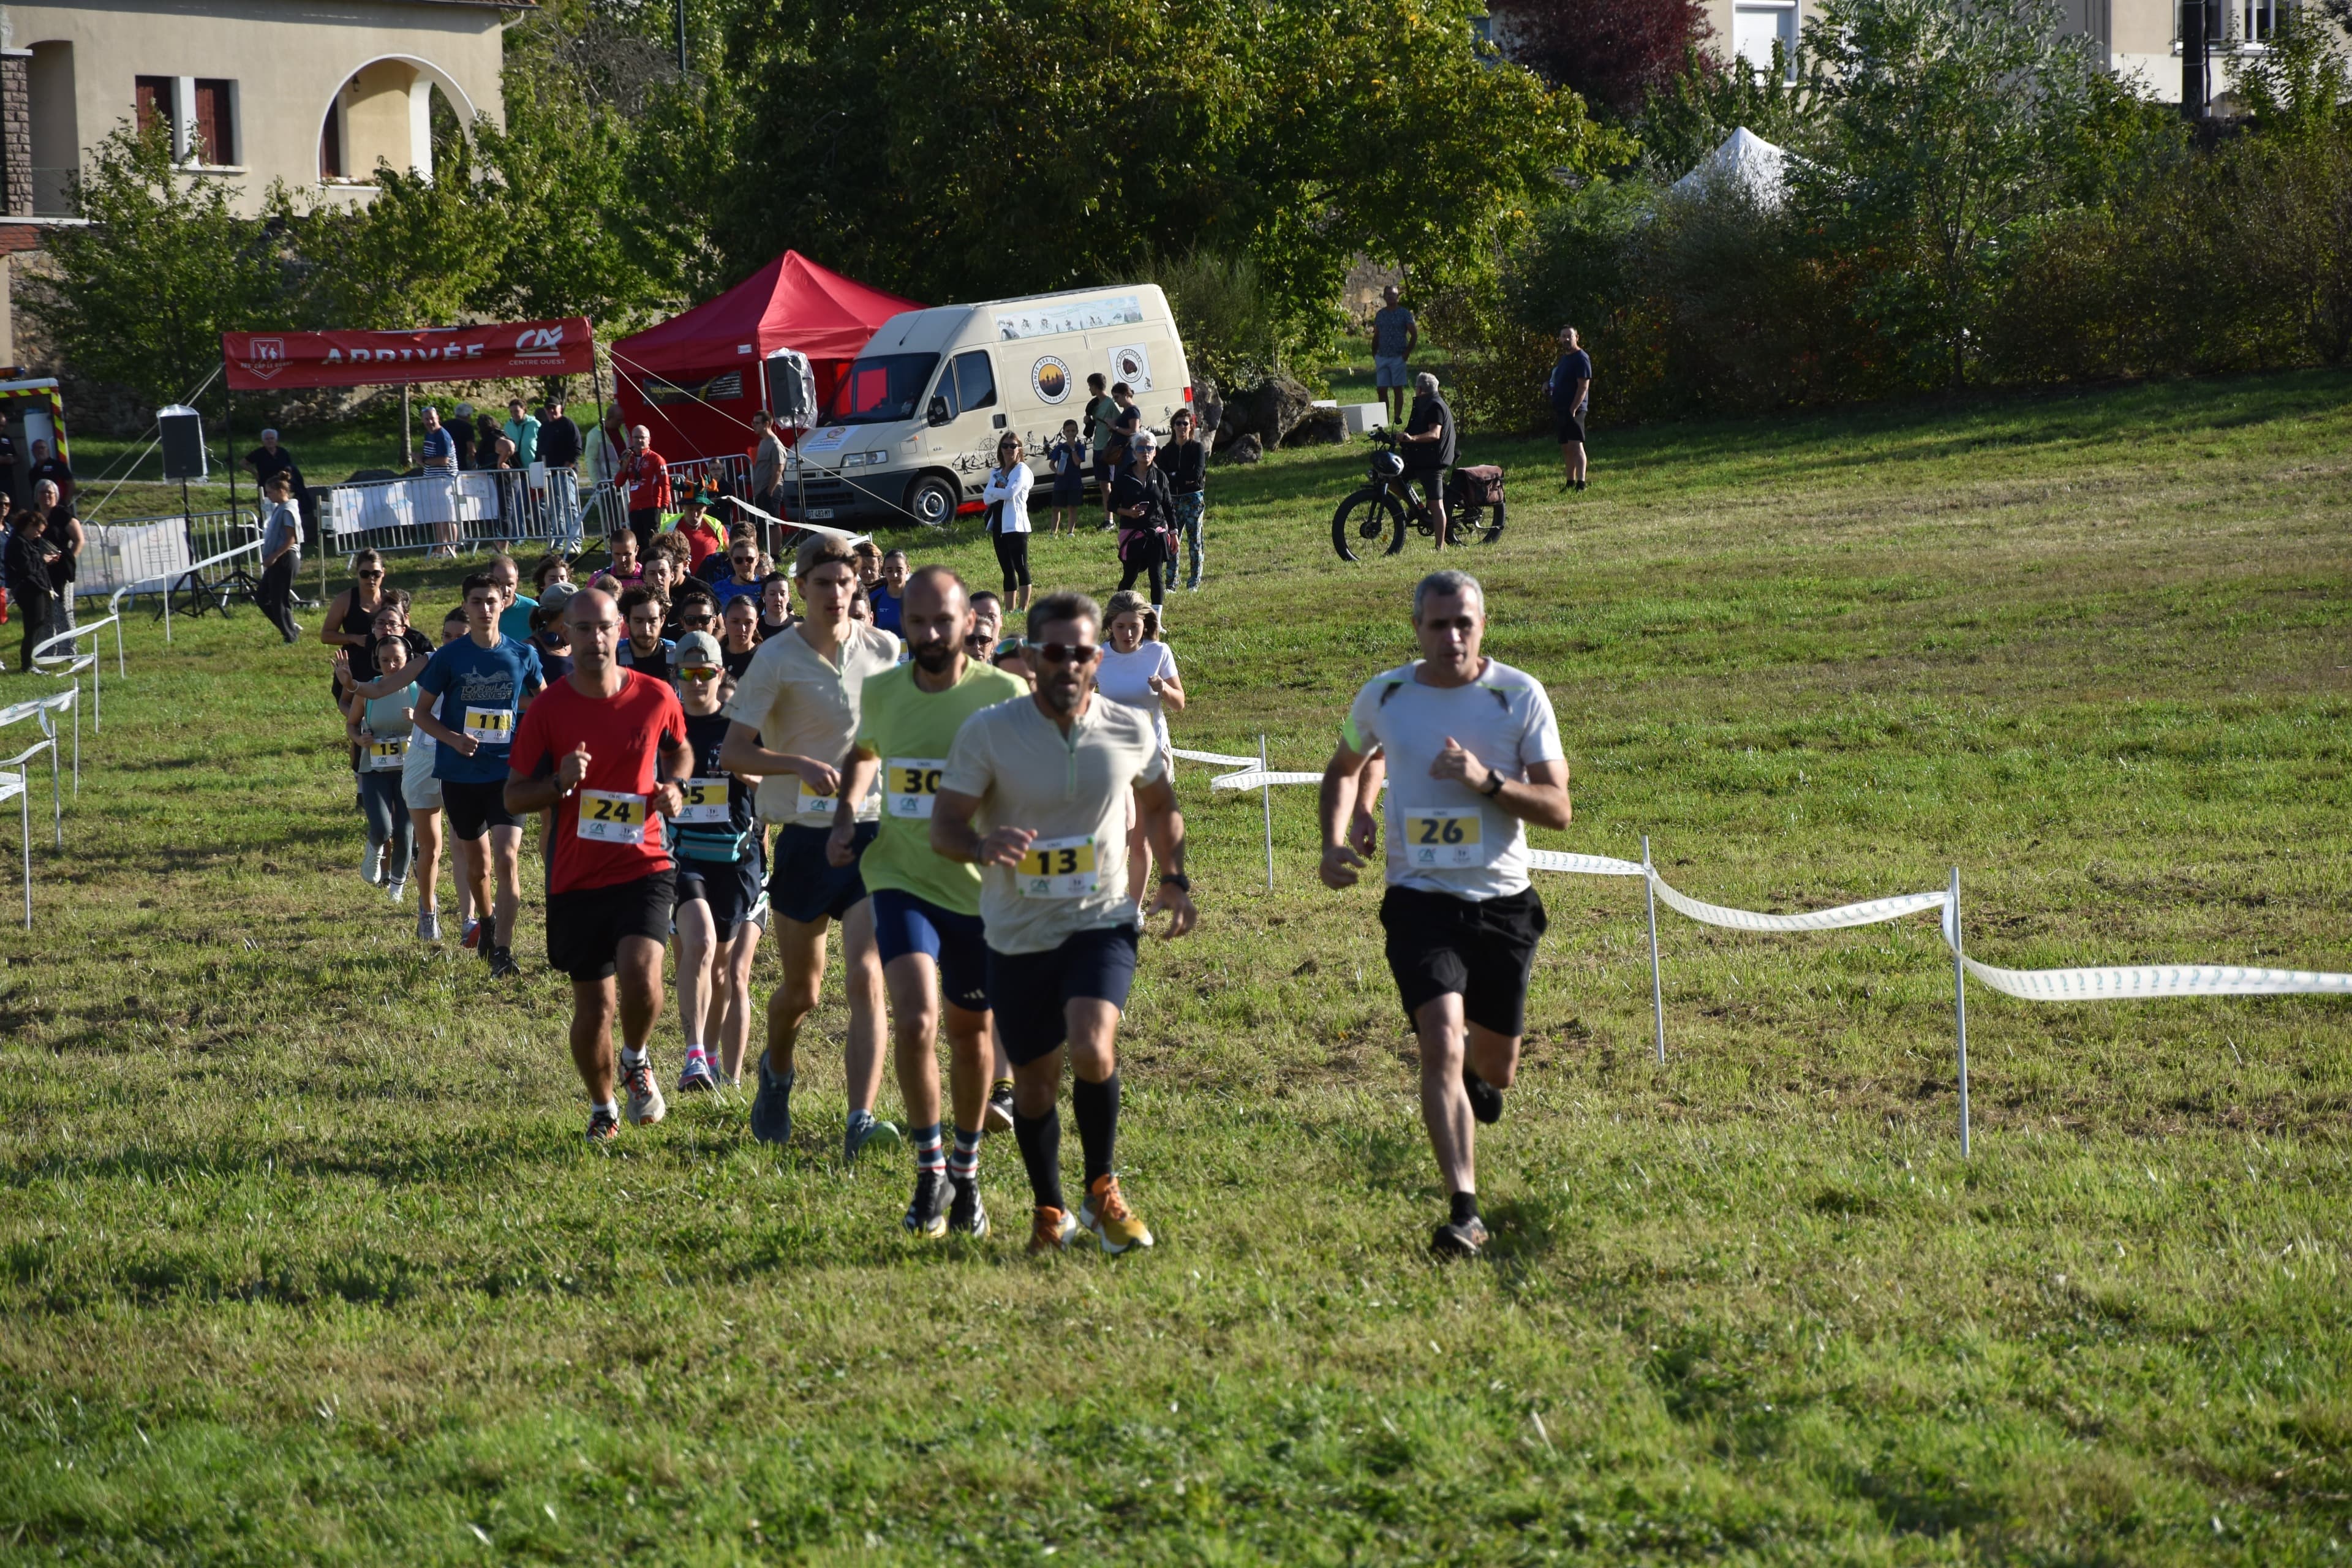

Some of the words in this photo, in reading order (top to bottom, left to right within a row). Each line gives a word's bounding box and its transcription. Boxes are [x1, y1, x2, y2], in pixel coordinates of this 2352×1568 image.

[461, 685, 484, 693] TOUR
[494, 682, 513, 690] LAC
[480, 714, 500, 729] 11
[380, 742, 398, 755] 15
[904, 769, 942, 794] 30
[594, 799, 631, 823] 24
[1420, 818, 1464, 844] 26
[1038, 848, 1077, 875] 13
